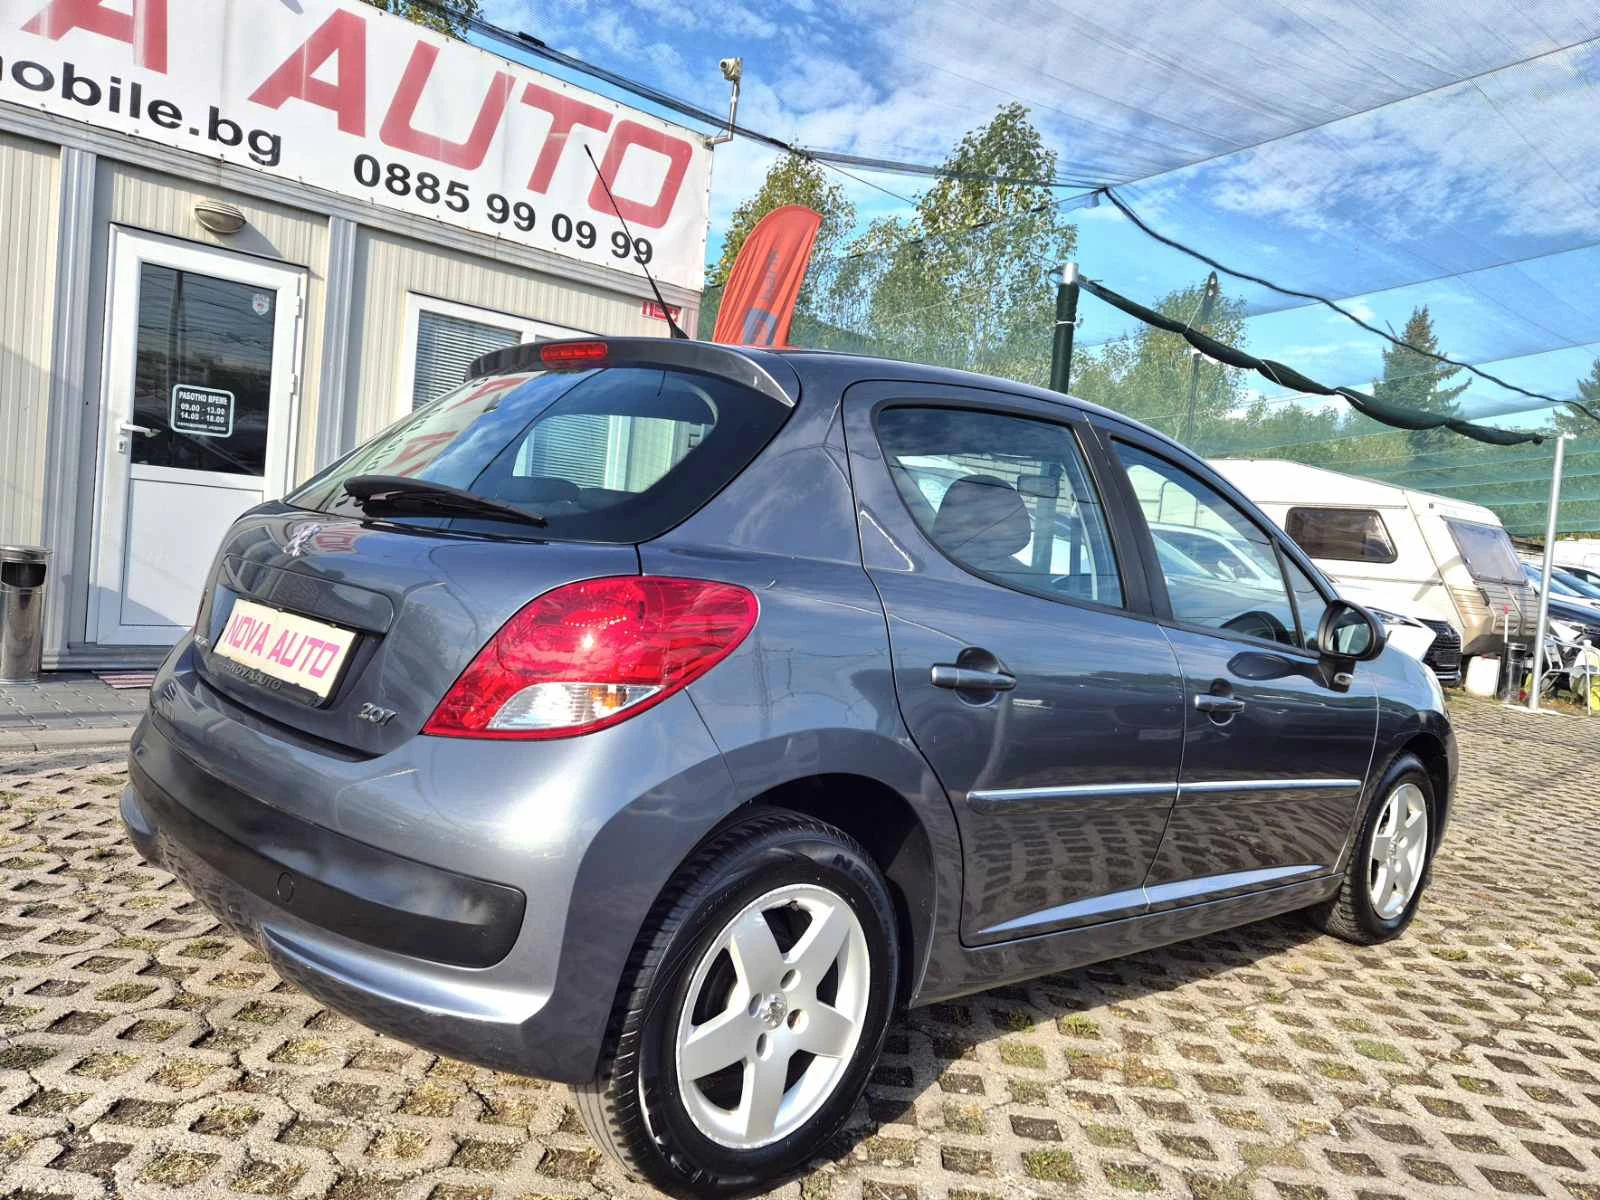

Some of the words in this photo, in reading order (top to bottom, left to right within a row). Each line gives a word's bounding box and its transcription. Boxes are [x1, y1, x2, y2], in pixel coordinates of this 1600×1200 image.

[0, 55, 282, 167] obile.bg
[247, 8, 692, 229] AUTO
[353, 153, 470, 213] 0885
[486, 193, 536, 232] 99
[551, 213, 597, 249] 09
[611, 230, 654, 265] 99
[223, 613, 271, 657] NOVA
[266, 629, 341, 679] AUTO
[357, 702, 398, 727] 207
